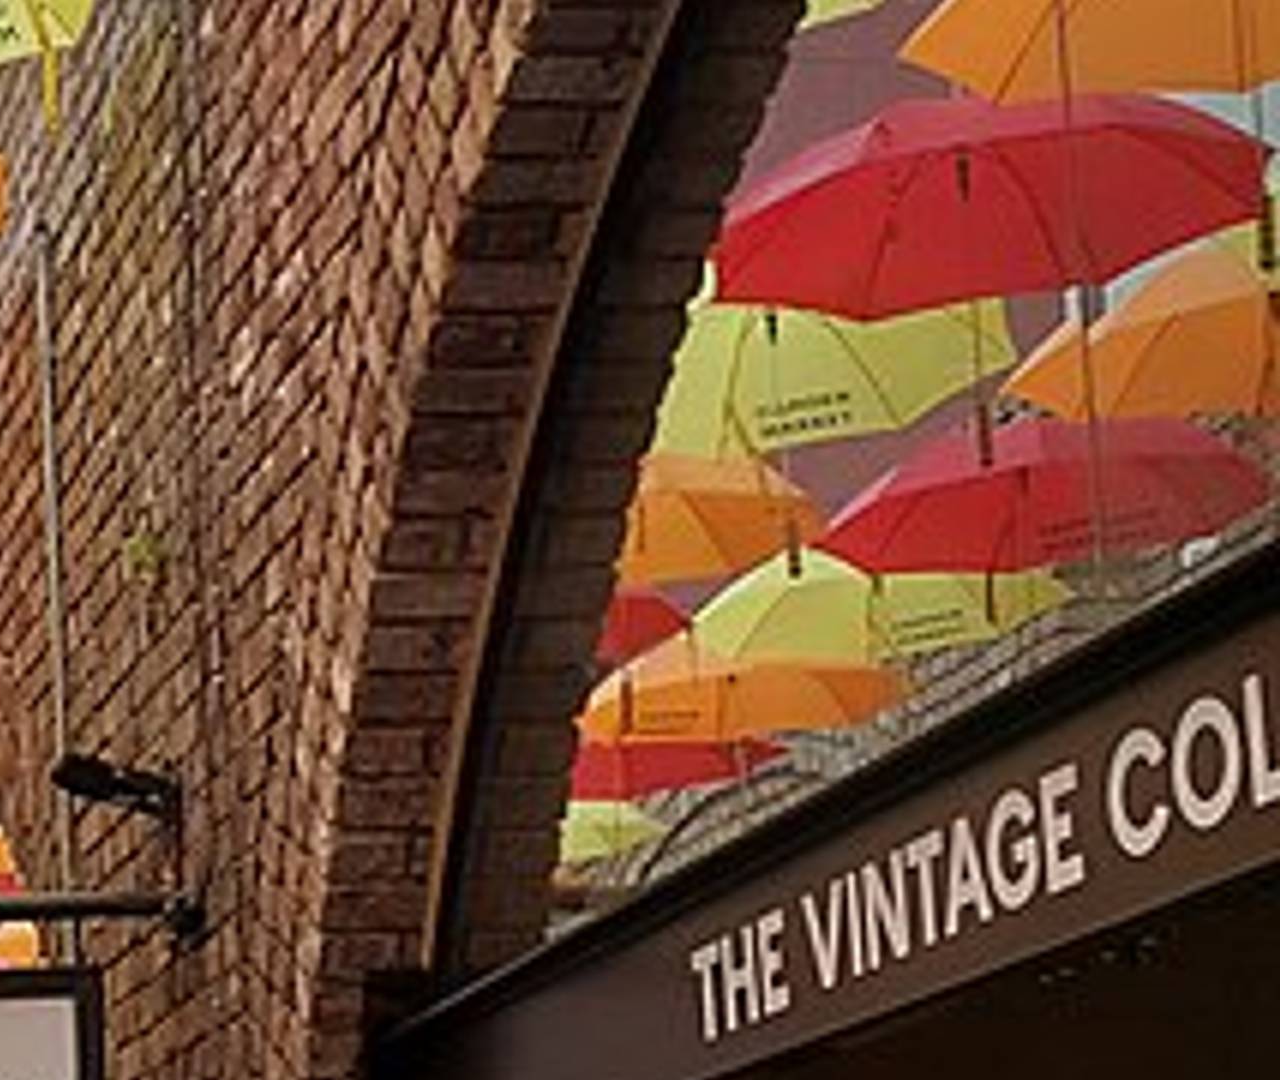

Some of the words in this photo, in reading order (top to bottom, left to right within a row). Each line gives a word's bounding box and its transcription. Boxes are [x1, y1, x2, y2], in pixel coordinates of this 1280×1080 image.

[691, 908, 791, 1042] THE
[800, 763, 1086, 990] VINTAGE
[1107, 673, 1280, 858] COL
